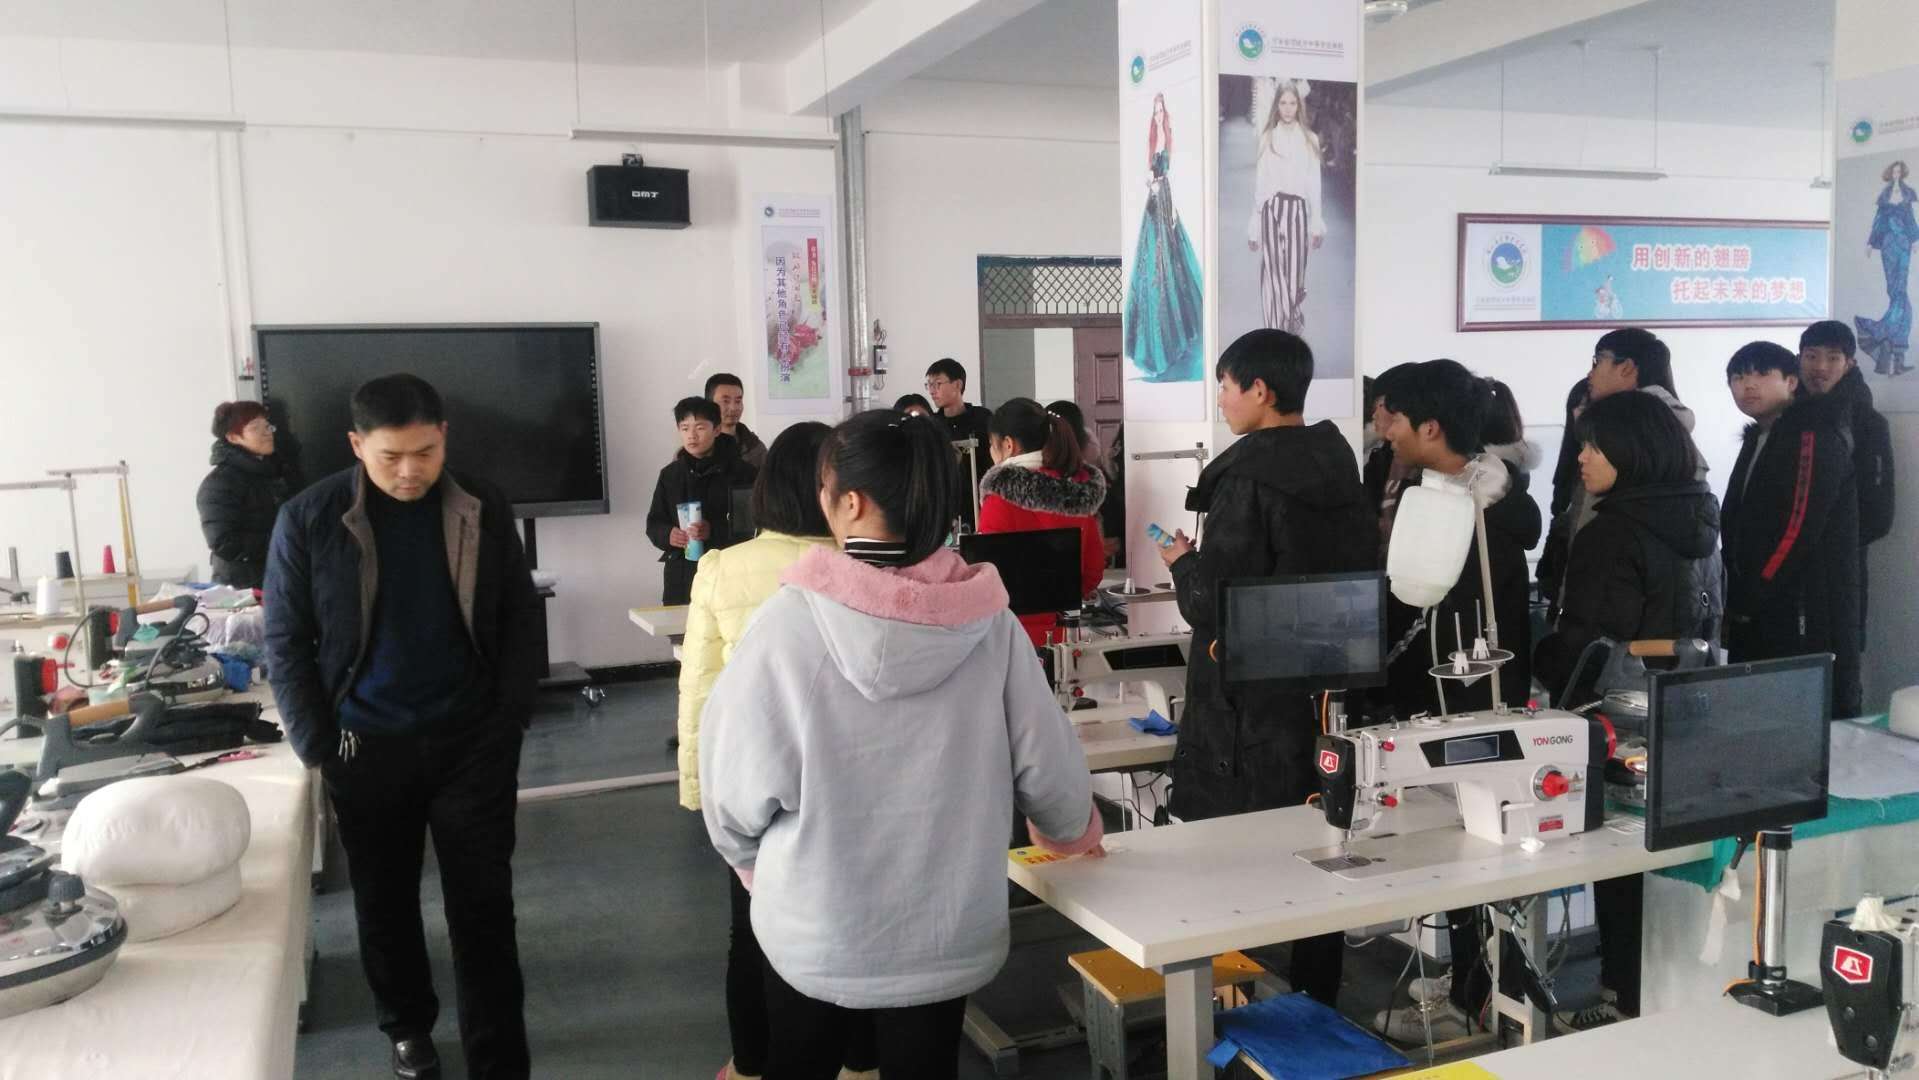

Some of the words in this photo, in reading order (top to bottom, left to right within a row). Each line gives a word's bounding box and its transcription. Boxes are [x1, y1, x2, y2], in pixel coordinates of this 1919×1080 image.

[1672, 278, 1804, 303] 托起未来的梦想
